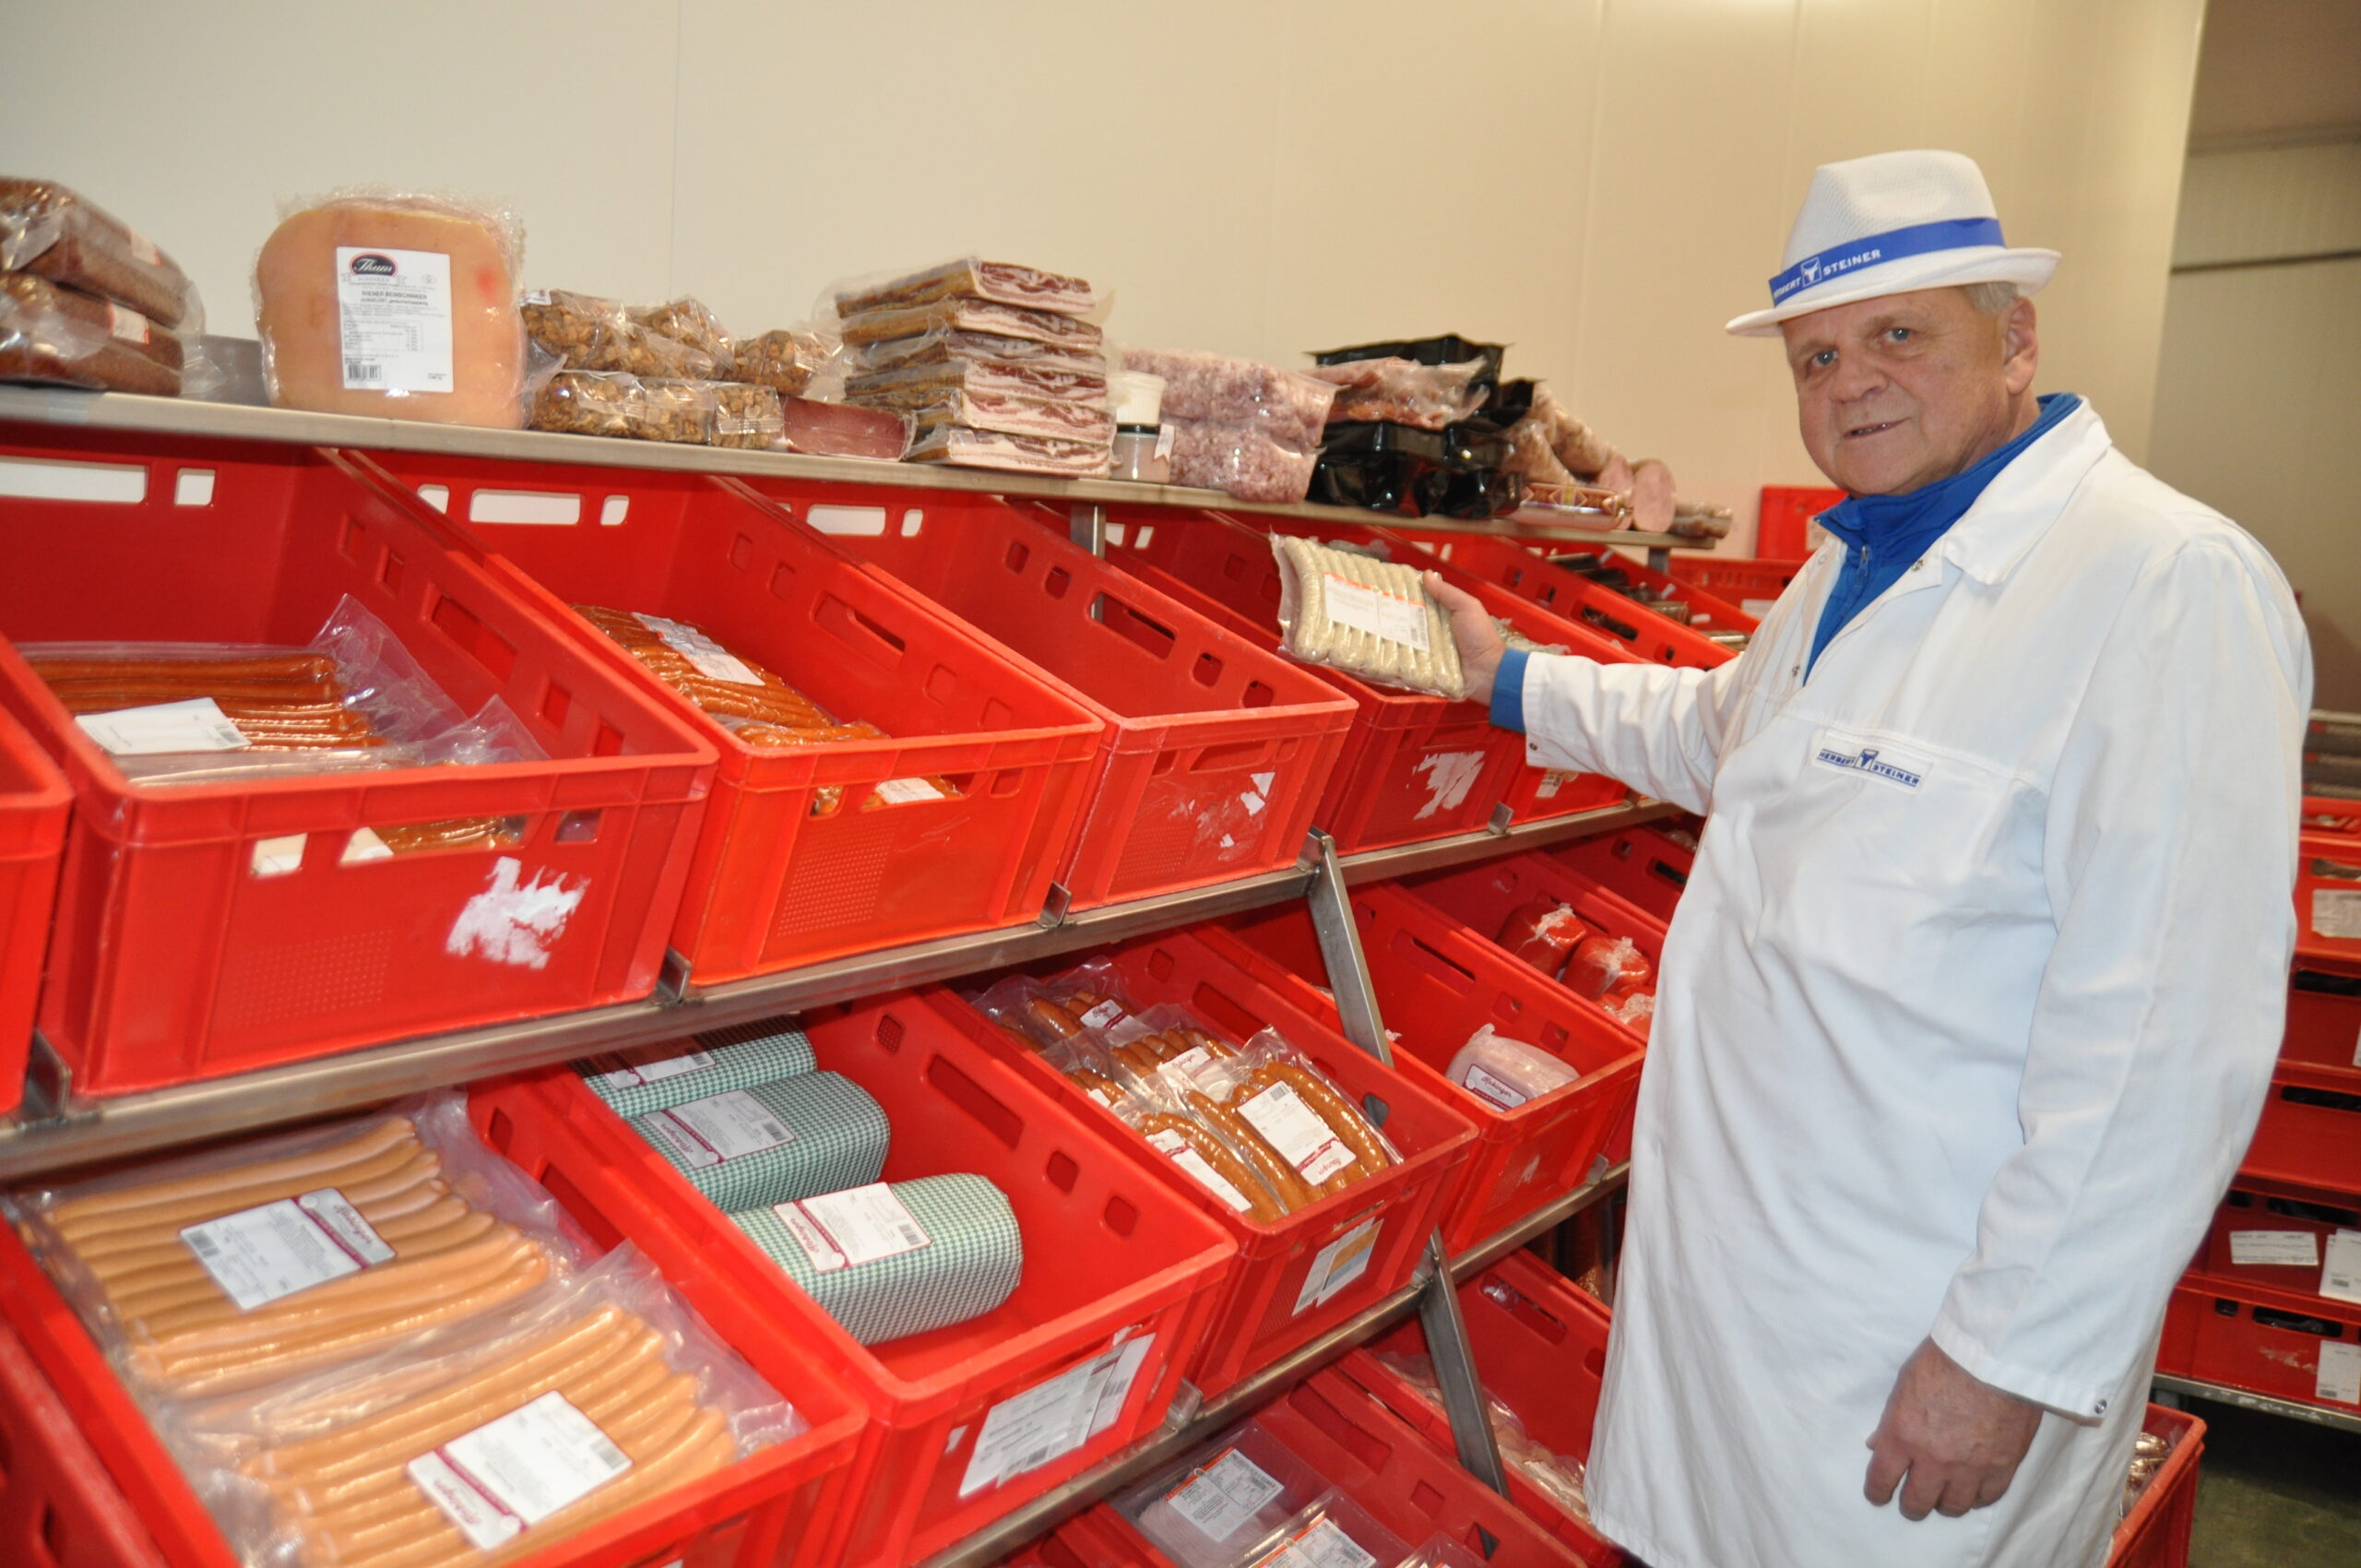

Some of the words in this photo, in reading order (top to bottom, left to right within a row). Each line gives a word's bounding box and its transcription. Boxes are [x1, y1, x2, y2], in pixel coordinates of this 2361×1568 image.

[1822, 248, 1881, 277] STEINER
[1819, 751, 1855, 765] HERBERT
[1872, 764, 1919, 785] STEINER
